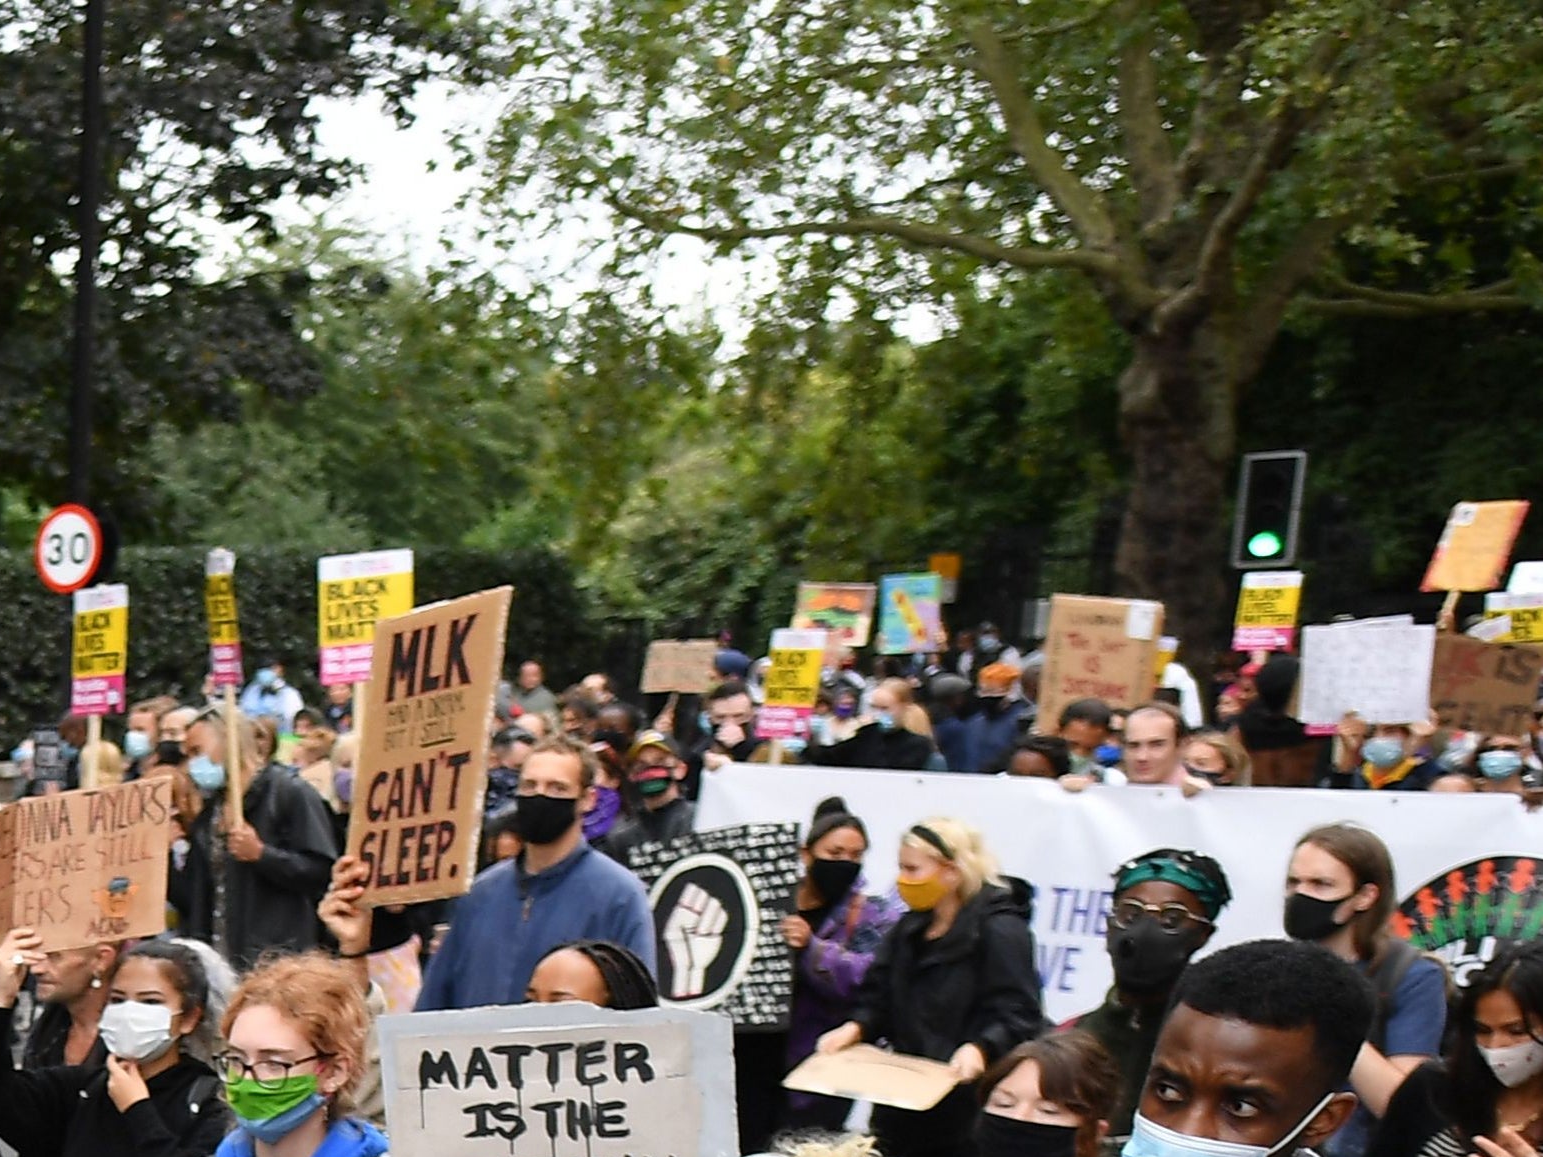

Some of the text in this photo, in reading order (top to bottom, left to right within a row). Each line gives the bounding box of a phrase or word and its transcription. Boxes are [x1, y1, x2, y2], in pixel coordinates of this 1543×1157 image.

[47, 532, 89, 566] 30
[385, 613, 480, 704] MLK
[367, 751, 471, 822] CAN'T
[96, 834, 155, 870] STILL
[1052, 887, 1114, 937] THE
[419, 1040, 655, 1090] MATTER
[463, 1099, 630, 1141] IS THE
